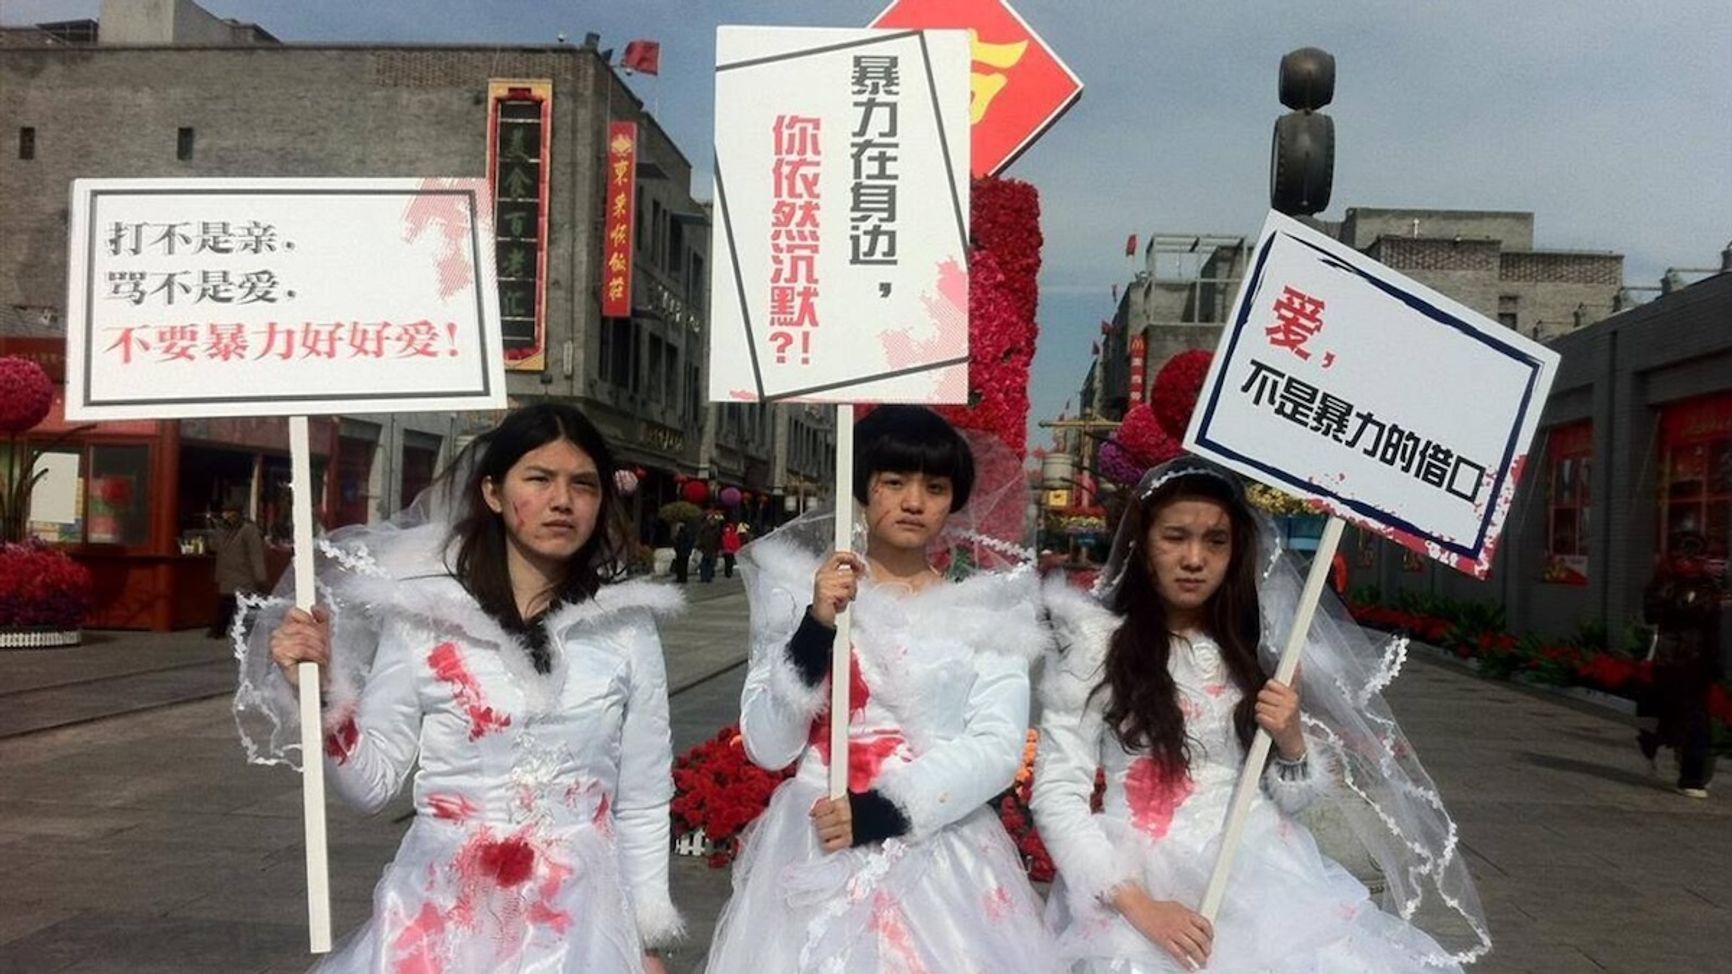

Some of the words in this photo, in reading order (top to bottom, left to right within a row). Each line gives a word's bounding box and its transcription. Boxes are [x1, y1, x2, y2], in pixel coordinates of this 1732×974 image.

[769, 114, 822, 365] 你依然沉默?!
[102, 319, 461, 364] 不要暴力好好爱!
[1240, 358, 1486, 504] 不是暴力的借口
